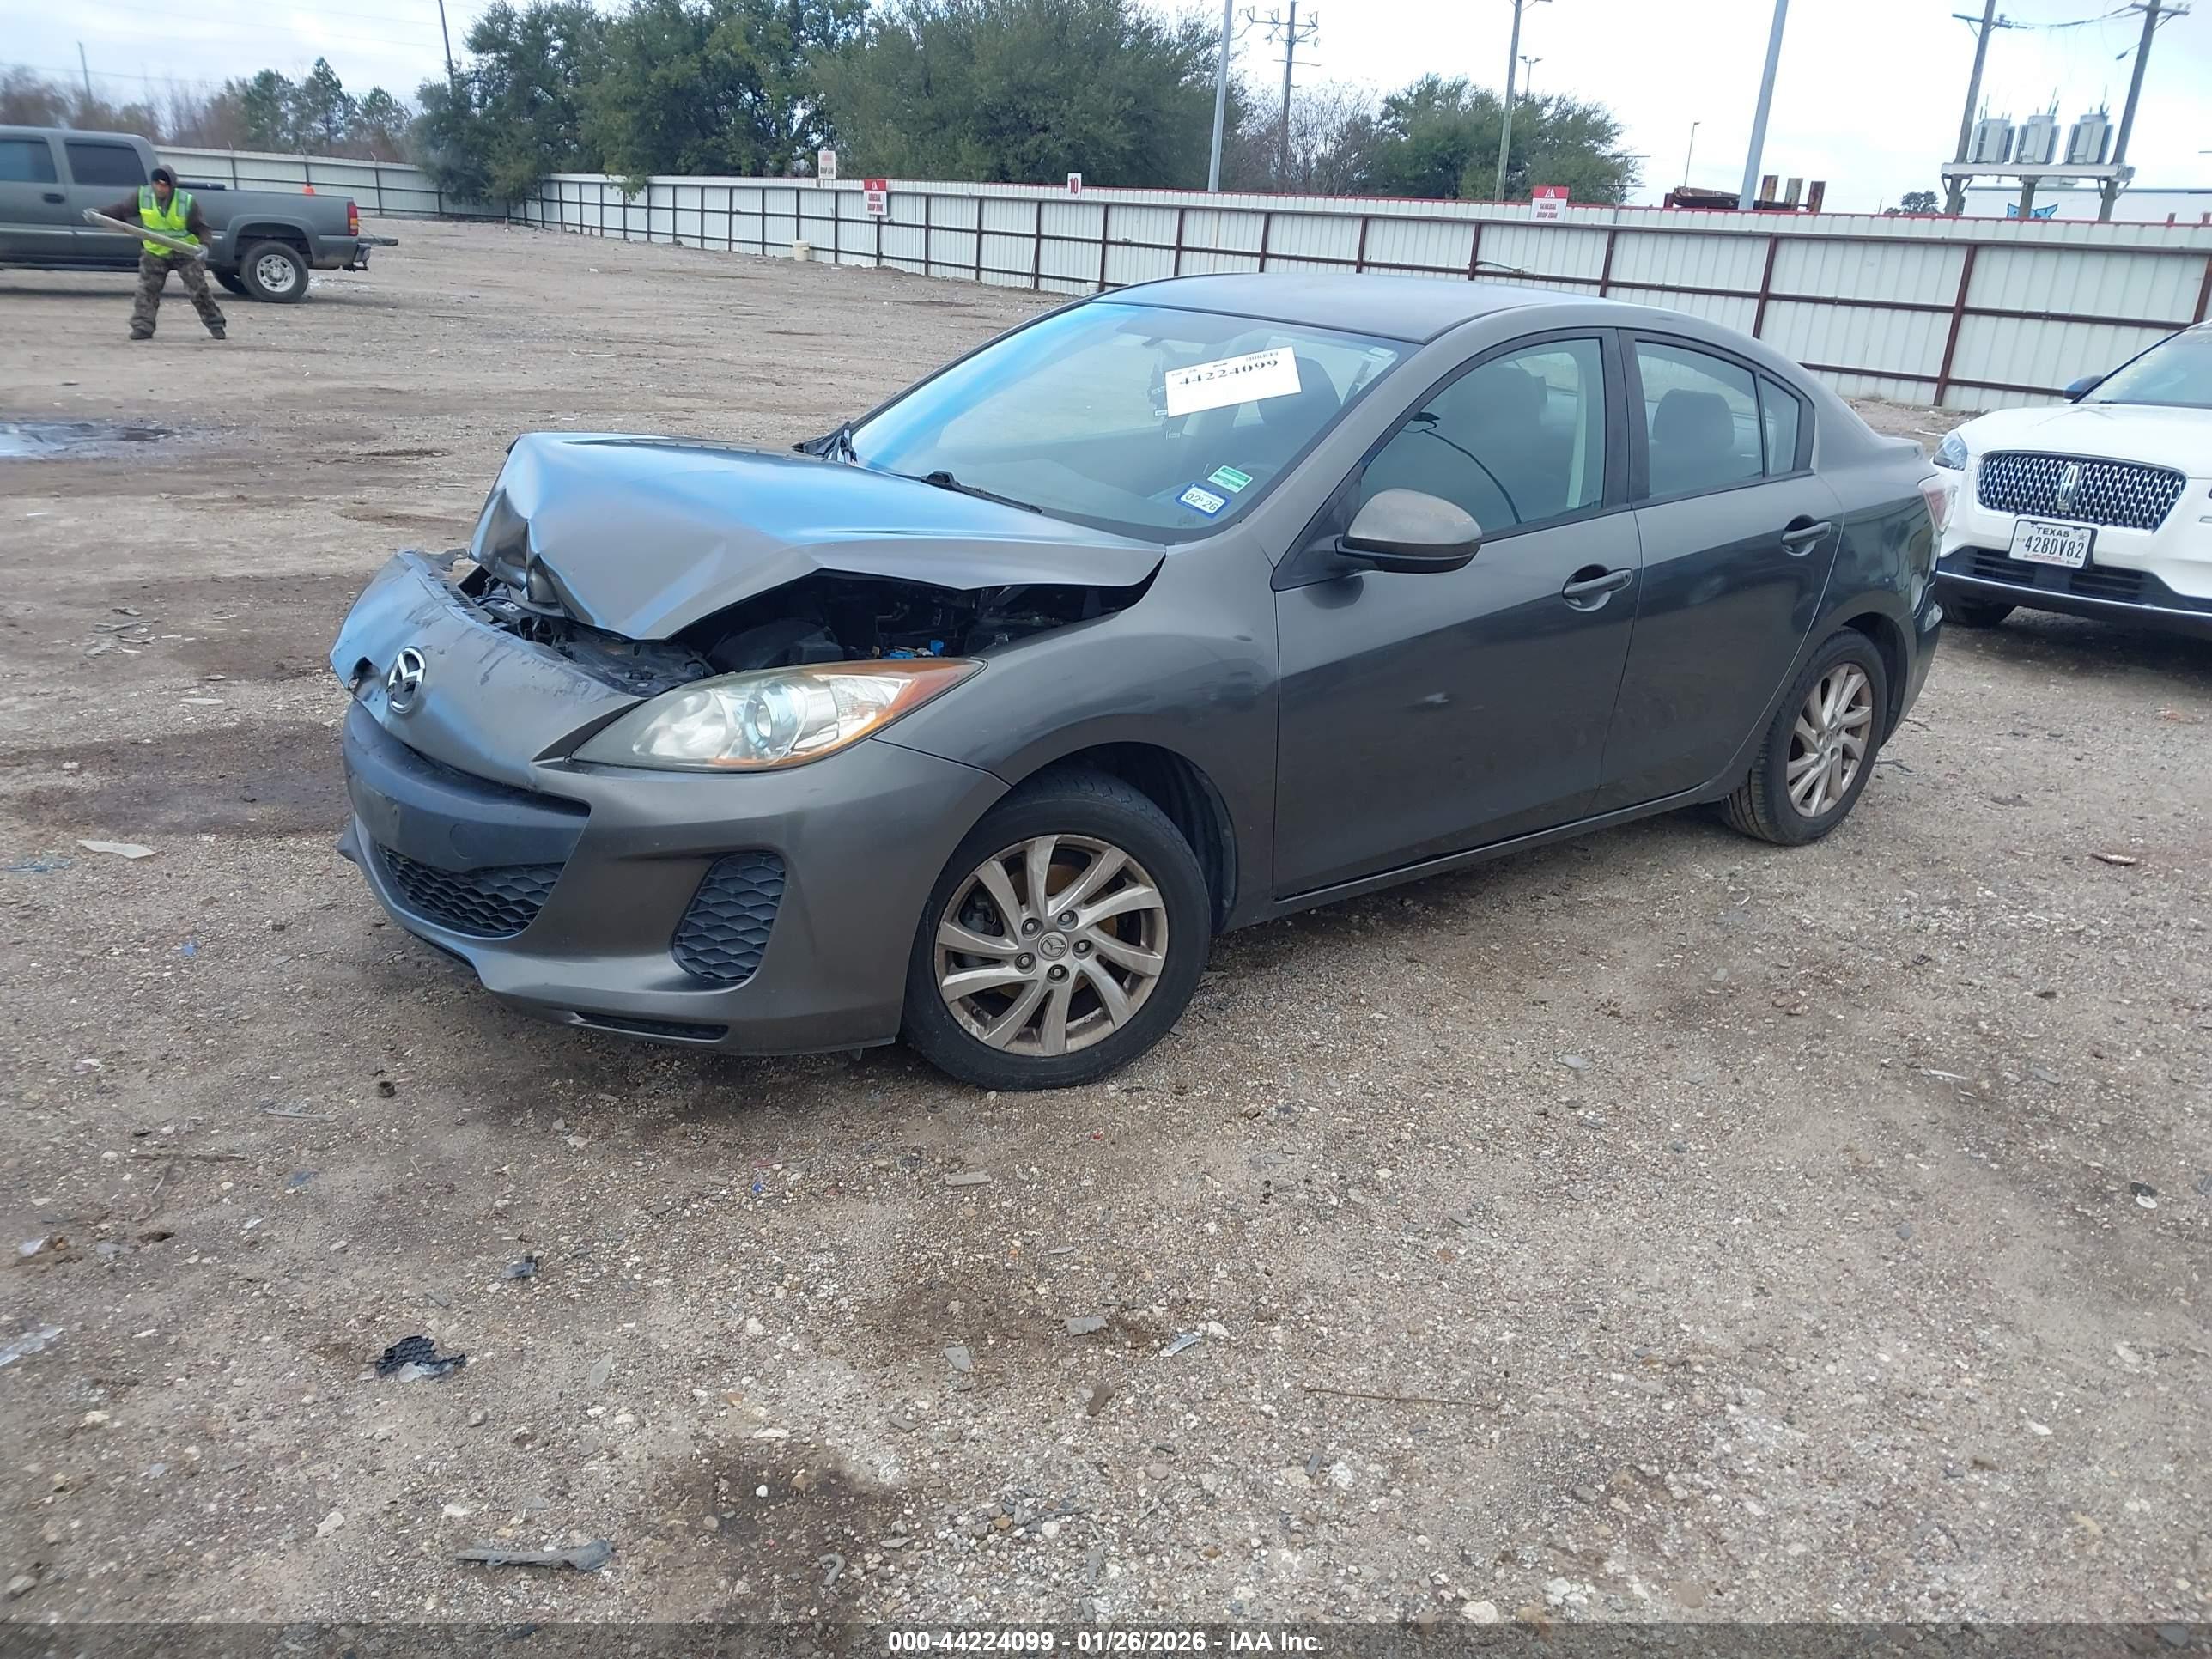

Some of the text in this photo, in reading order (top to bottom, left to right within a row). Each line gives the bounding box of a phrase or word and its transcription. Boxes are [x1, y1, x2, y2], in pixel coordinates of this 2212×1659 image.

[1069, 177, 1079, 194] 10
[1179, 358, 1279, 385] 44224099
[2036, 526, 2070, 538] TEXAS
[2025, 535, 2085, 559] 428DV82
